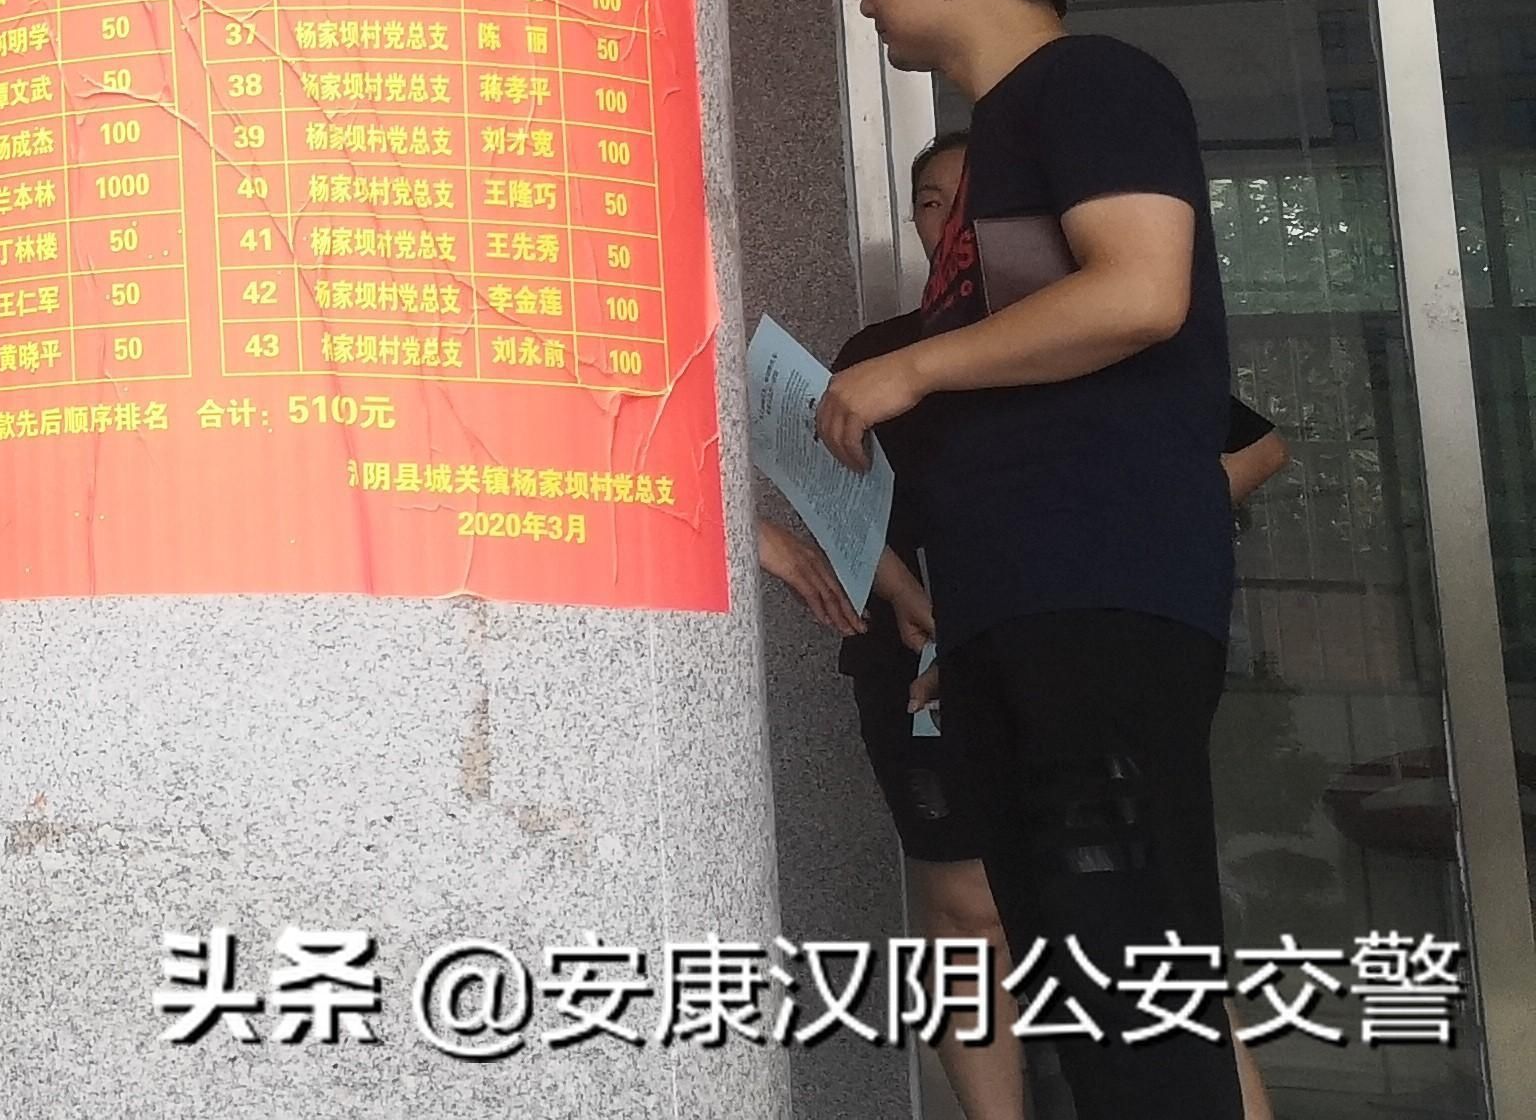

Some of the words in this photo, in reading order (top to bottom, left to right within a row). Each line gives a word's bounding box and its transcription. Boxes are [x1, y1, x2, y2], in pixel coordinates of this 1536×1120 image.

[101, 15, 130, 40] 50
[224, 22, 258, 46] 37
[294, 20, 449, 51] 杨家坝村党总支
[597, 37, 619, 62] 50
[102, 68, 132, 93] 50
[228, 72, 263, 97] 38
[595, 87, 628, 114] 100
[100, 119, 141, 145] 100
[233, 124, 265, 148] 39
[481, 126, 555, 158] 刘才宽
[597, 139, 631, 166] 100
[95, 172, 150, 199] 1000
[604, 191, 628, 217] 50
[109, 227, 138, 252] 50
[239, 228, 272, 251] 41
[486, 231, 560, 263] 王先秀
[607, 244, 631, 269] 50
[111, 282, 140, 306] 50
[242, 280, 278, 304] 42
[606, 296, 639, 322] 100
[114, 336, 143, 361] 50
[244, 333, 280, 358] 43
[609, 349, 643, 375] 100
[457, 512, 588, 545] 2020年3月
